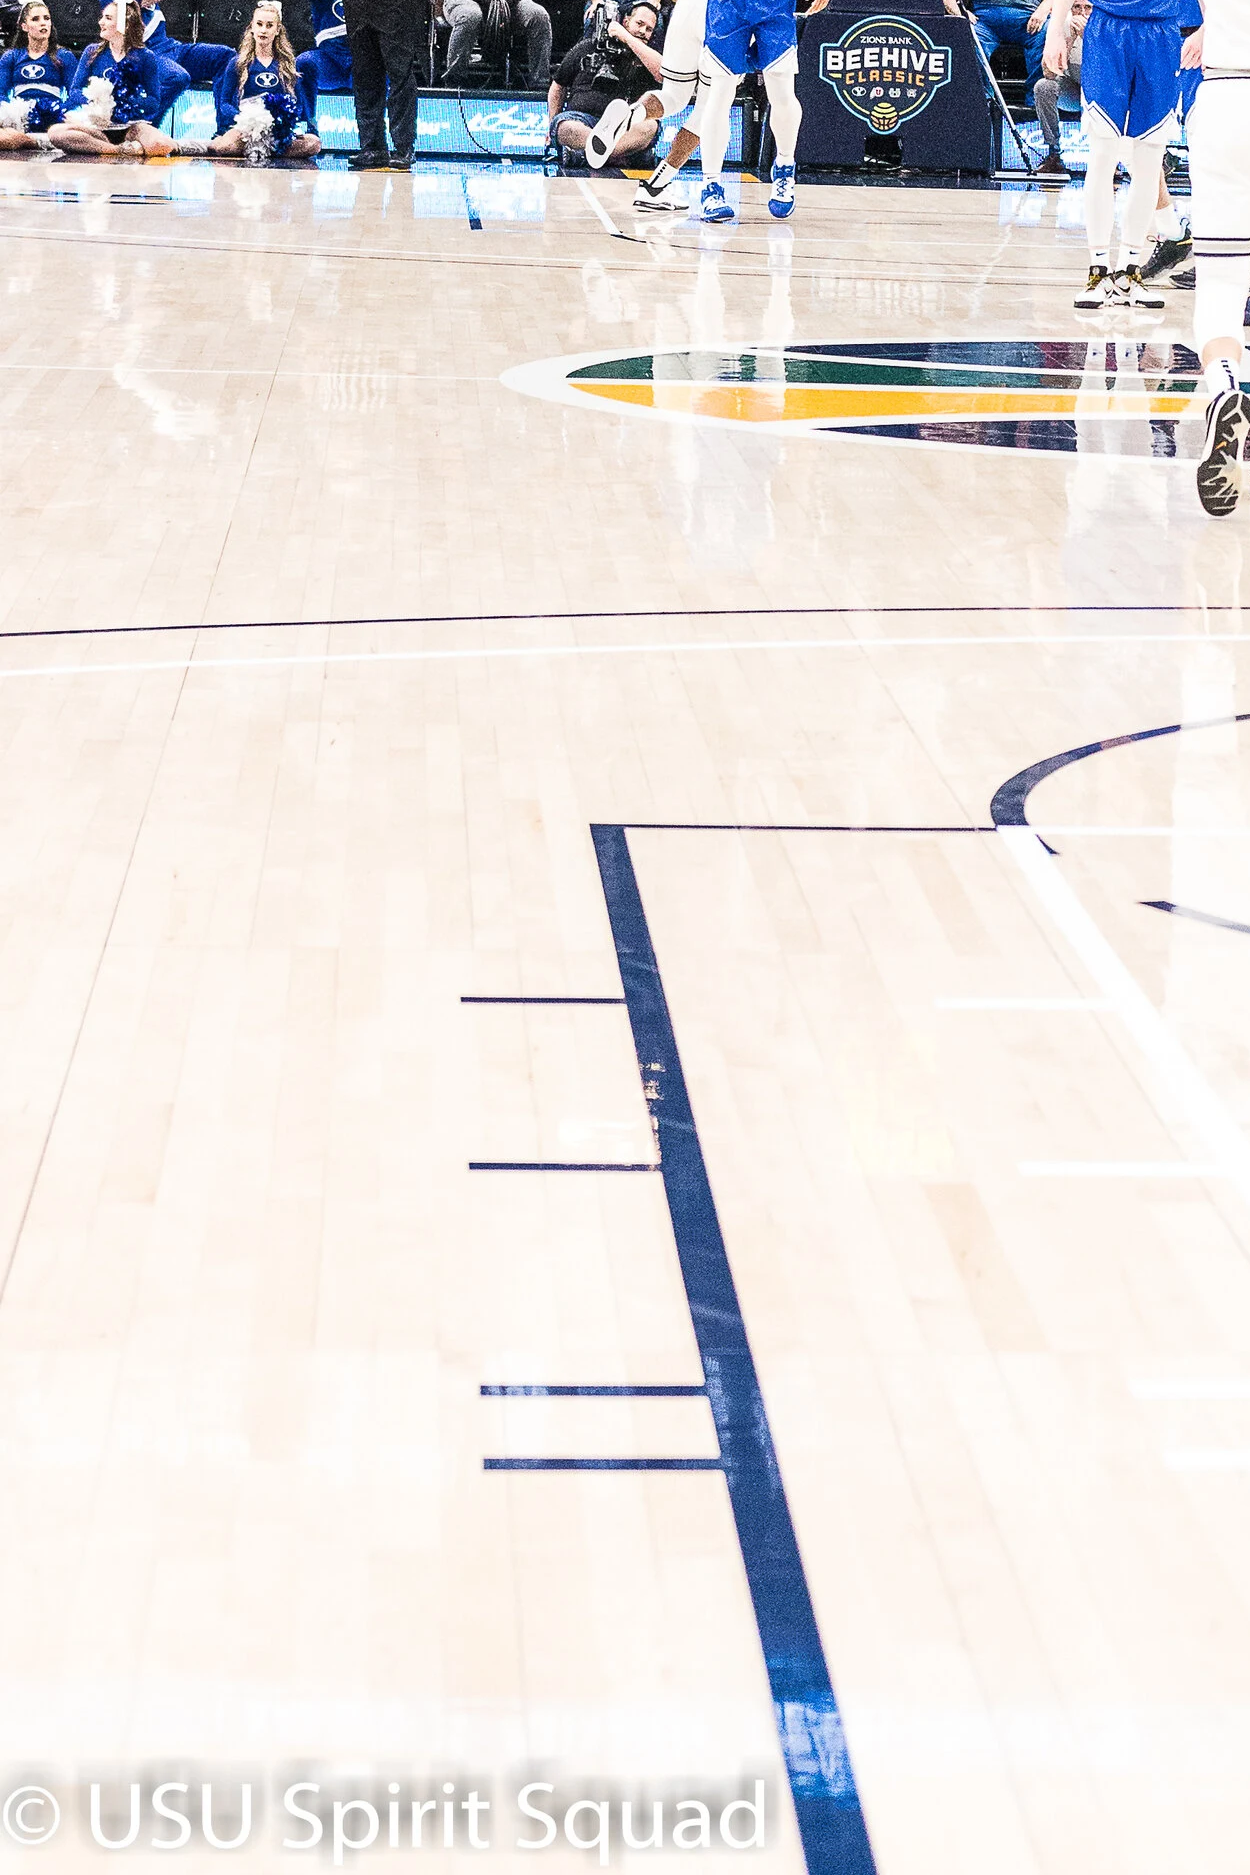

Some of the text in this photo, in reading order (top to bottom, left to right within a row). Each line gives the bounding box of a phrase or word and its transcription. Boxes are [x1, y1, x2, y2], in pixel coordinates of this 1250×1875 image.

[860, 36, 912, 45] ZIONS BANK
[826, 47, 945, 74] BEEHIVE
[845, 69, 925, 87] CLASSIC
